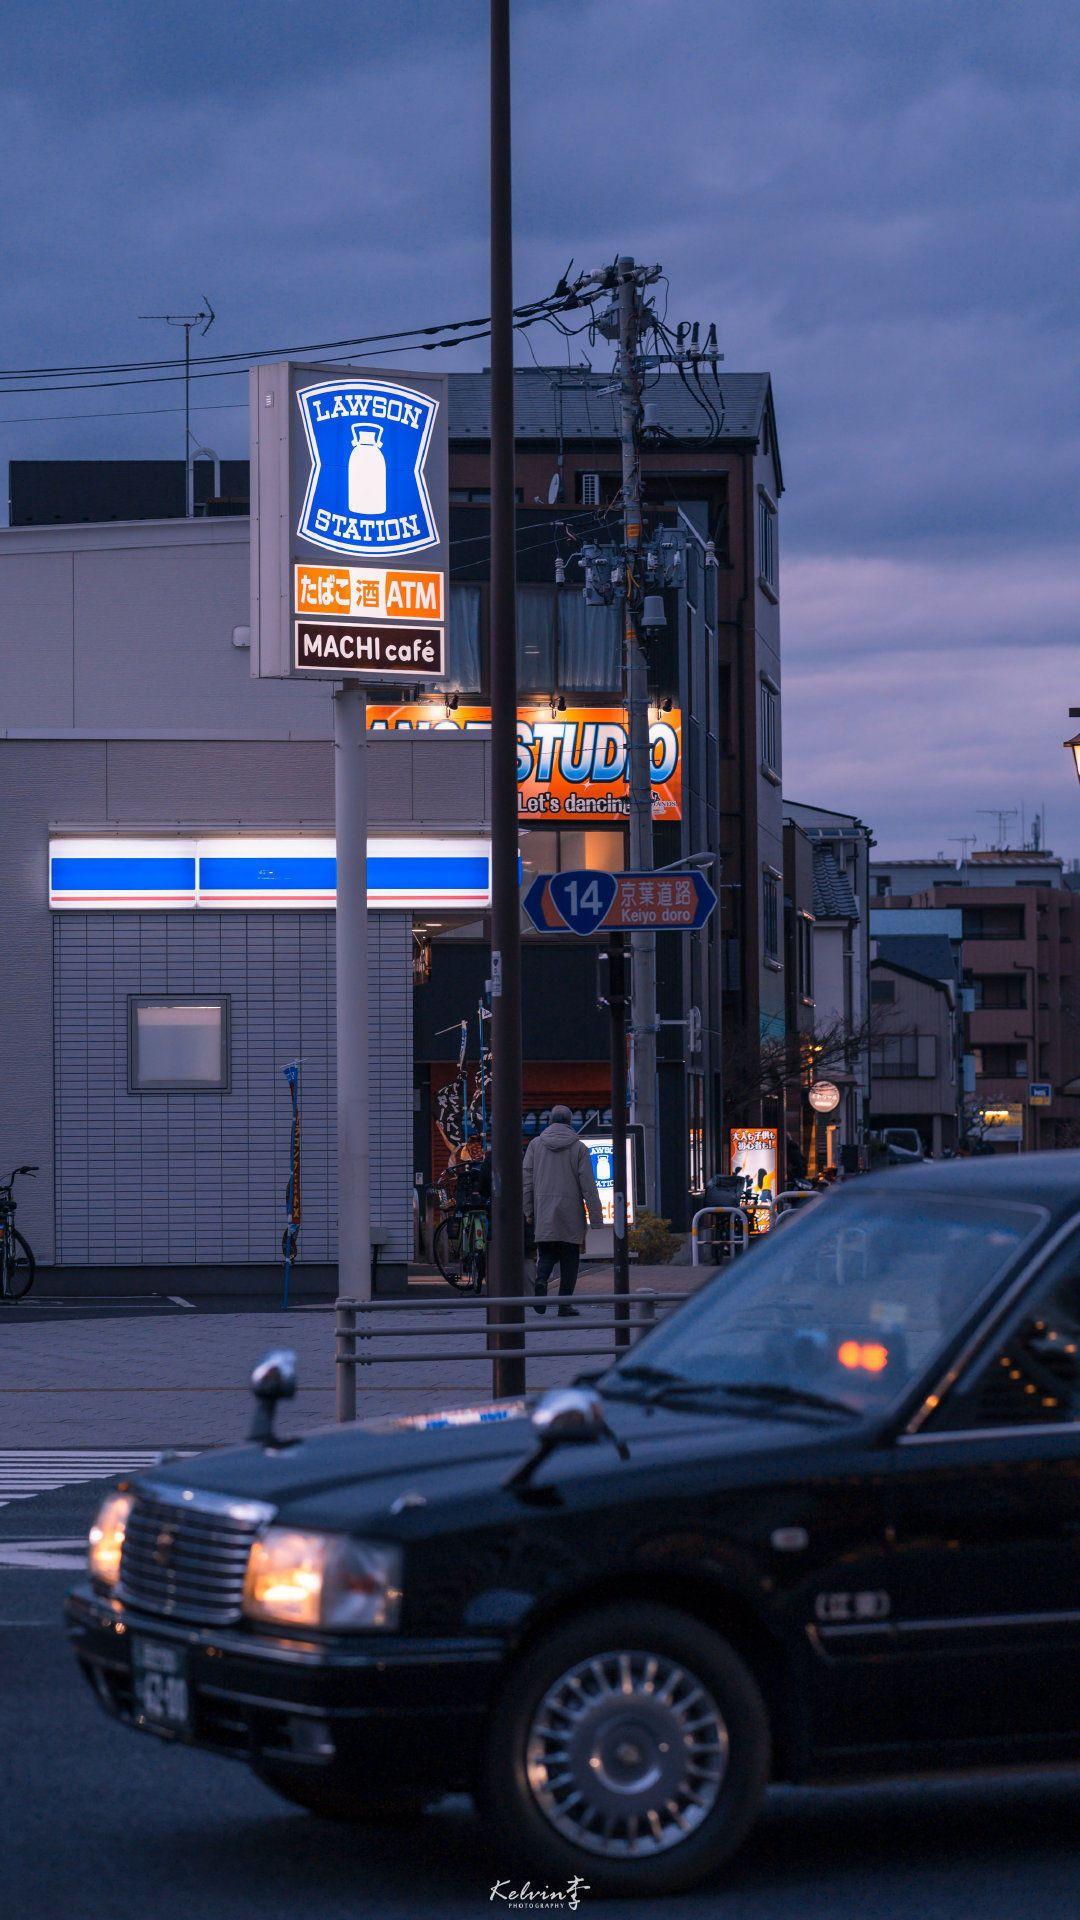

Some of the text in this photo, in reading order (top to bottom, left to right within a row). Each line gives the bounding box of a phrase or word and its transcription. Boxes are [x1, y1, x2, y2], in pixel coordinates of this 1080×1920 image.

[313, 395, 422, 429] LAWSON
[315, 508, 421, 541] STATION
[300, 574, 437, 610] たばこ 酒 ATM
[303, 633, 435, 663] MACHI café
[517, 791, 561, 814] Let's
[564, 880, 603, 916] 14
[620, 881, 691, 907] 京葉道路
[621, 908, 691, 924] Keiyo doro
